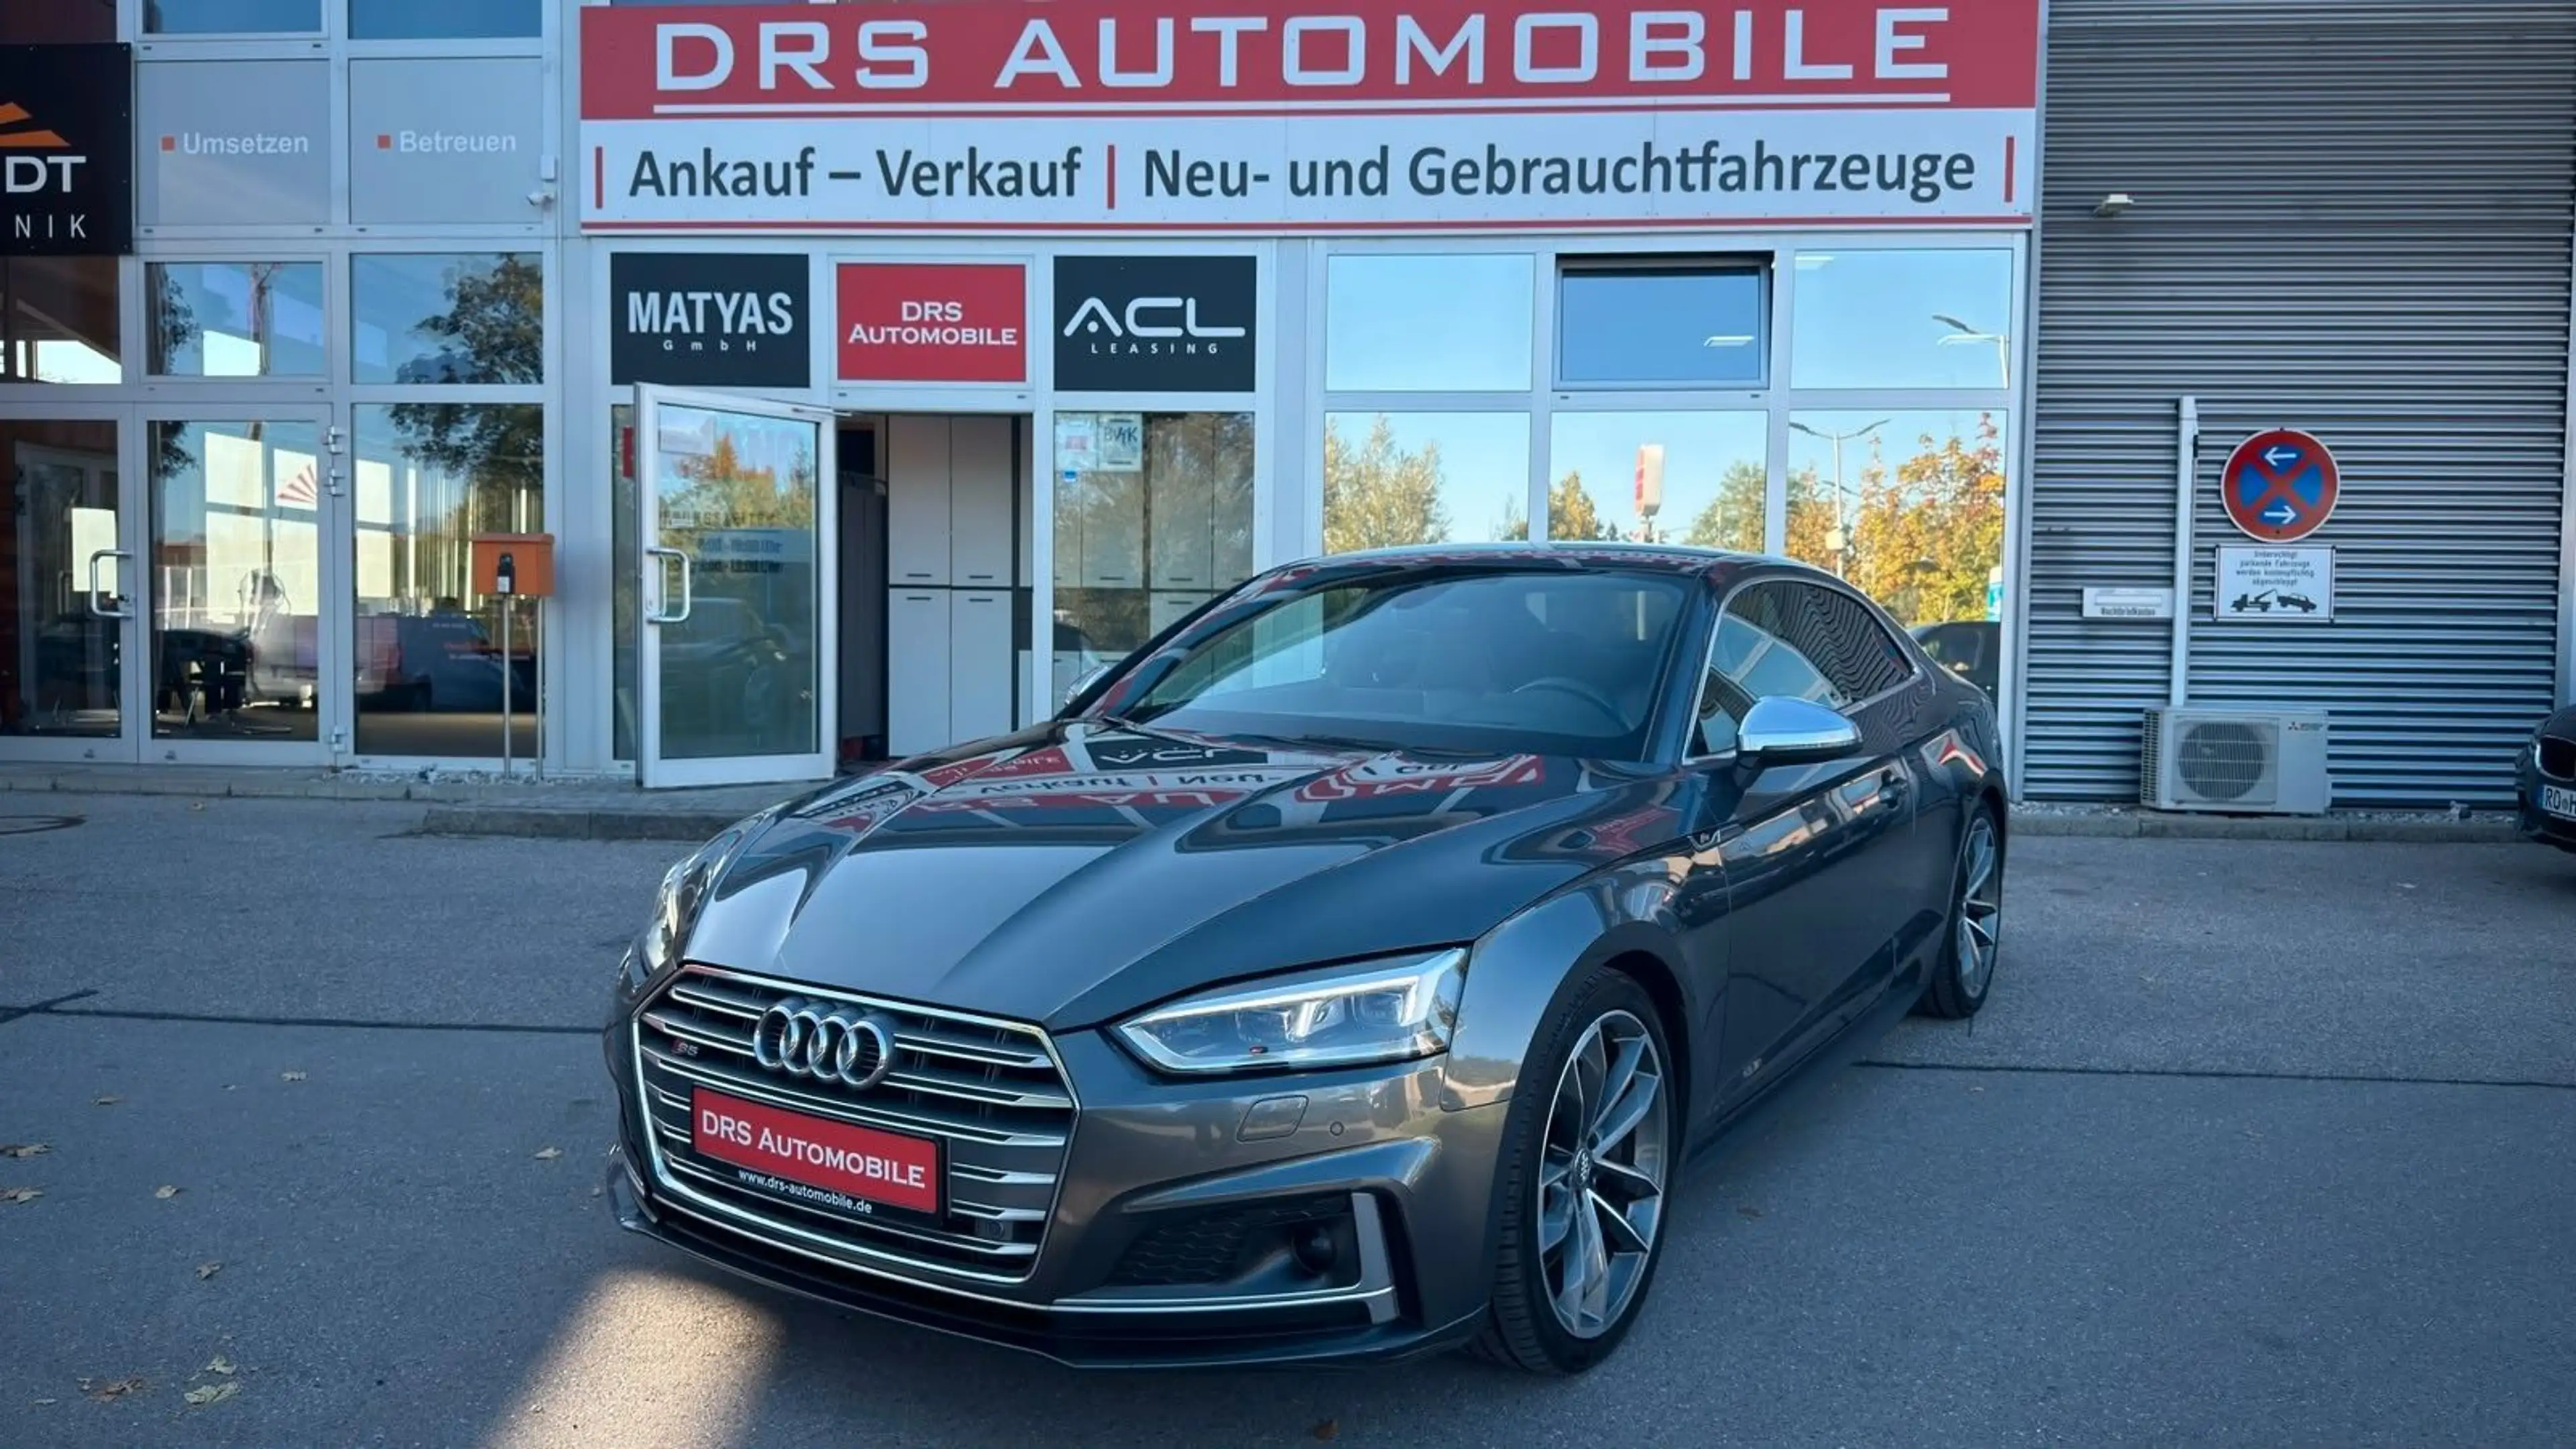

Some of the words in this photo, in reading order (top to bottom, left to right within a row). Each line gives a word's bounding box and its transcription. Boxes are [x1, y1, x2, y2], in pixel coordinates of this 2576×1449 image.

[656, 20, 929, 91] DRS
[993, 7, 1949, 89] AUTOMOBILE
[183, 132, 309, 154] Umsetzen
[400, 130, 517, 152] Betreuen
[628, 146, 816, 197] Ankauf
[875, 146, 1083, 198] Verkauf
[1144, 149, 1271, 198] Neu-
[1289, 144, 1389, 197] und
[1408, 140, 1976, 203] Gebrauchtfahrzeuge
[628, 291, 794, 335] MATYAS
[901, 301, 963, 323] DRS
[1063, 297, 1246, 337] ACL
[848, 323, 1018, 346] AUTOMOBILE
[1091, 343, 1220, 354] LEASING
[701, 1110, 753, 1146] DRS
[757, 1127, 926, 1189] AUTOMOBILE
[739, 1169, 872, 1214] www.drs-automobile.de
